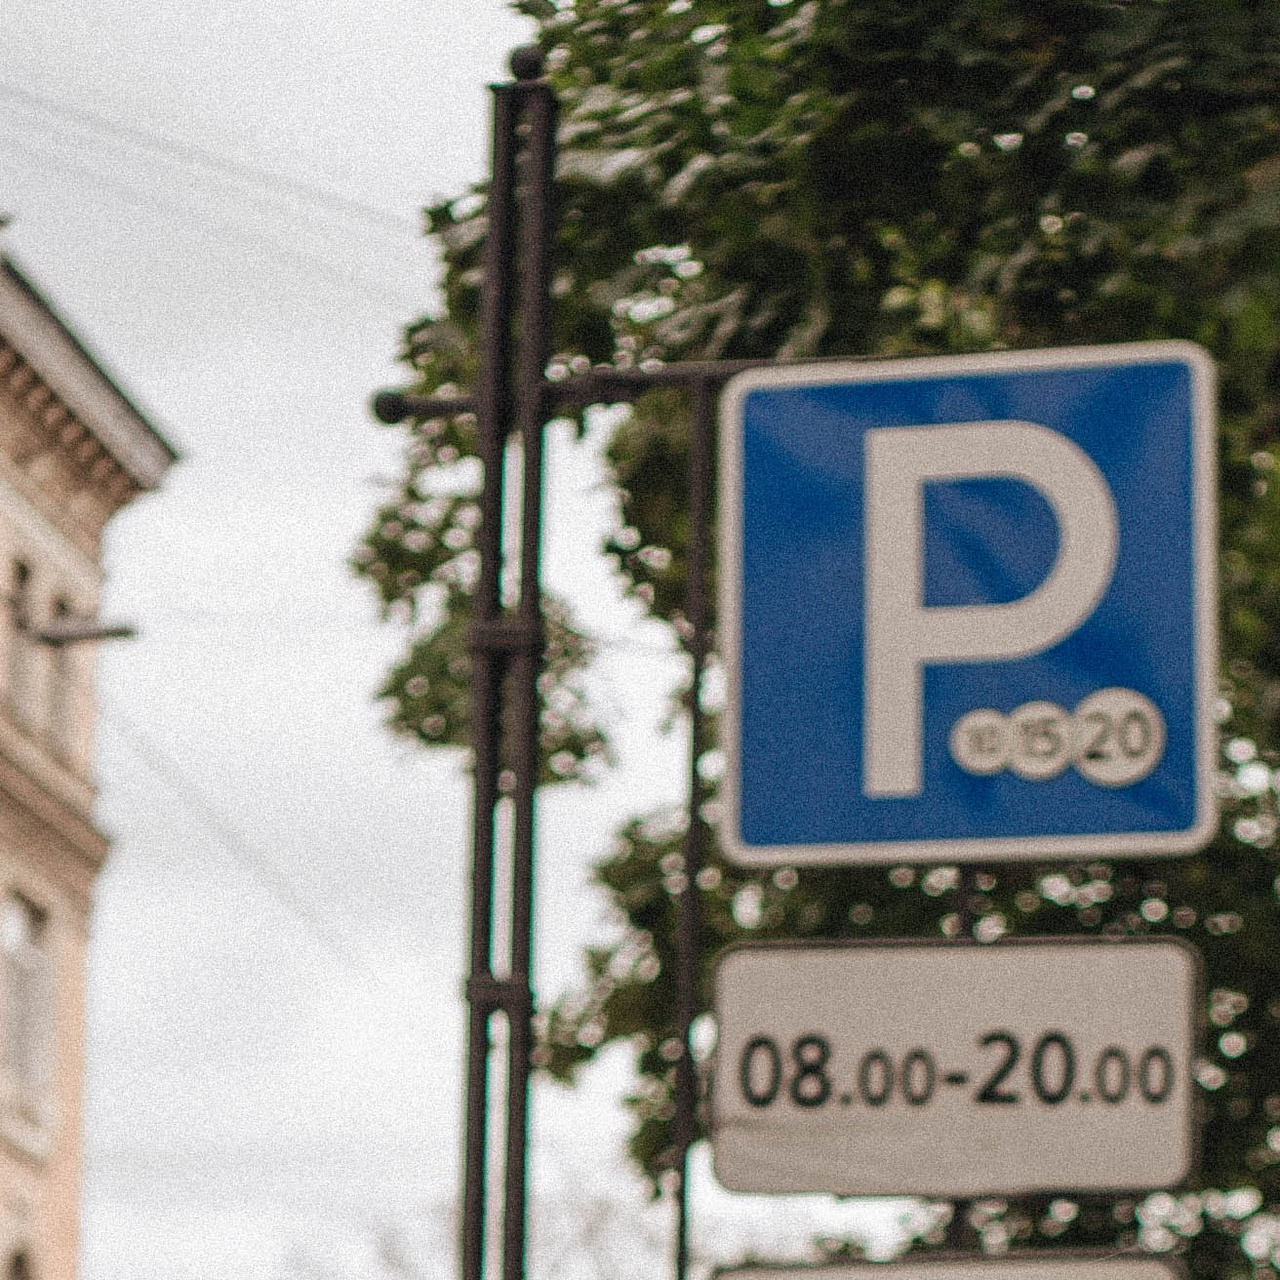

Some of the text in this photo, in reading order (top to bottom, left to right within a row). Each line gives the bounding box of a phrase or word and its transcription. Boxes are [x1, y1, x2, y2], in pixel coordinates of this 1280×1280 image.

[863, 420, 1120, 798] P
[1083, 709, 1152, 761] 20
[740, 1031, 1173, 1107] 08.00-20.00
